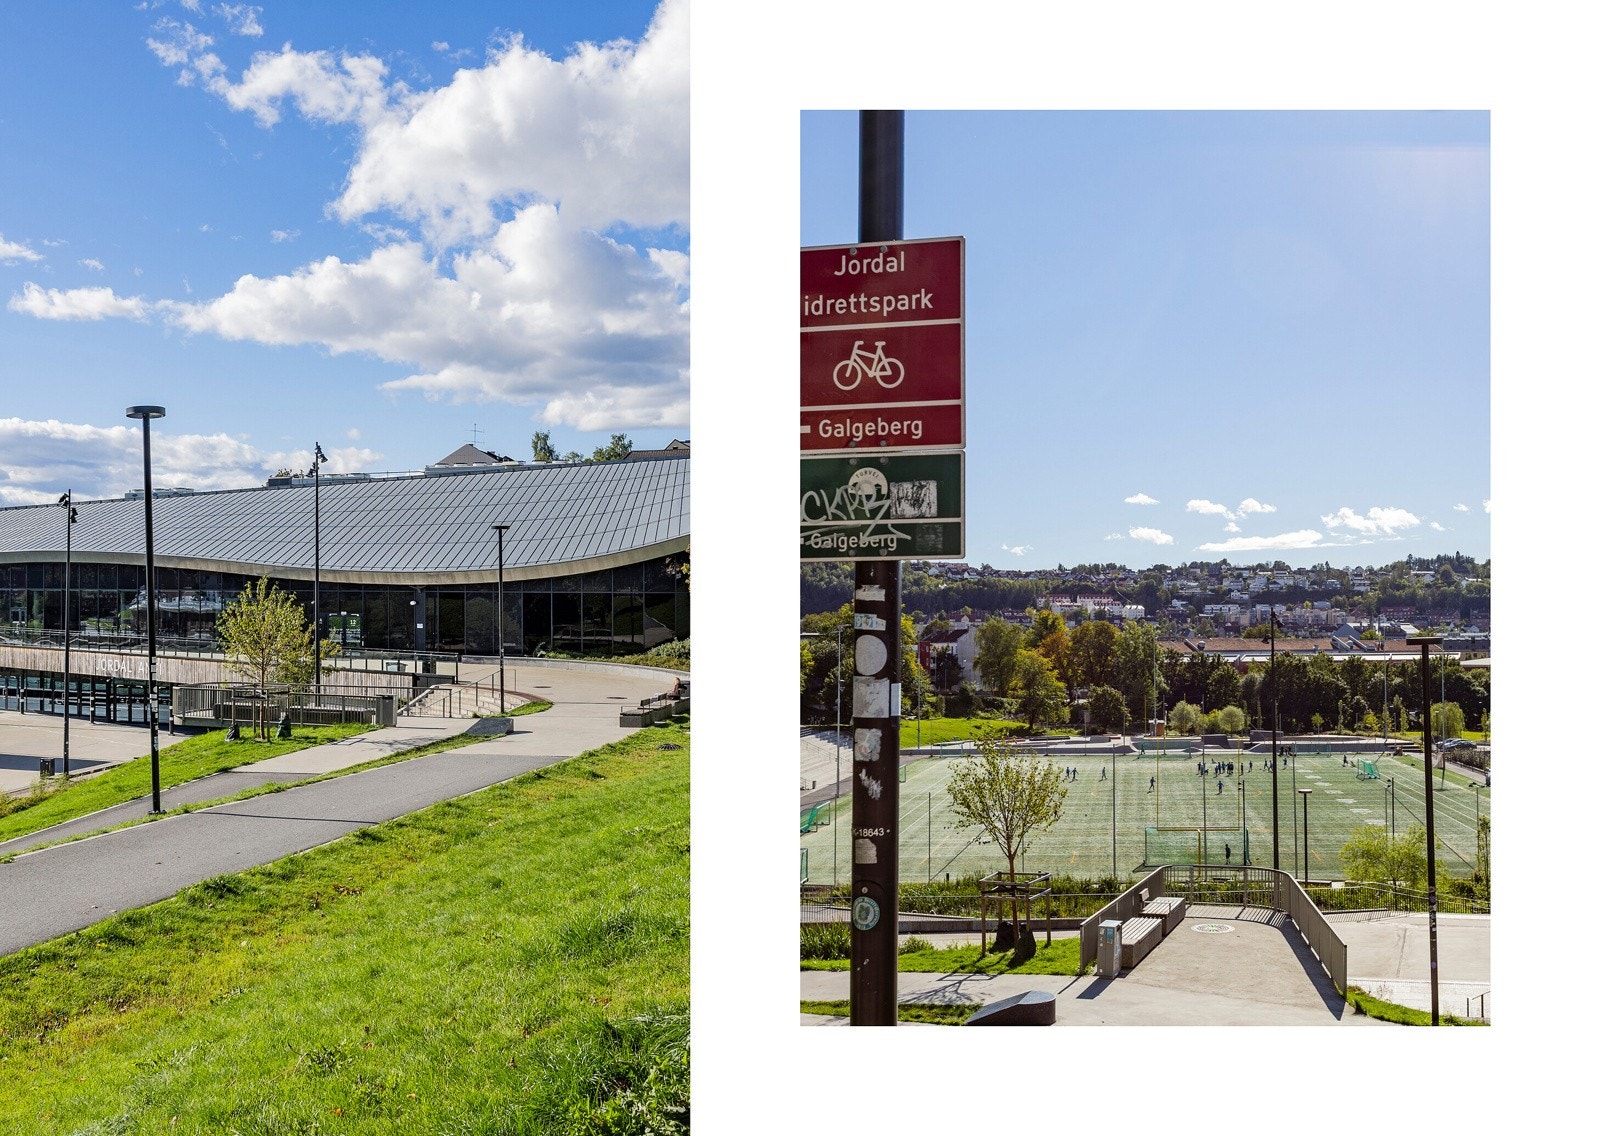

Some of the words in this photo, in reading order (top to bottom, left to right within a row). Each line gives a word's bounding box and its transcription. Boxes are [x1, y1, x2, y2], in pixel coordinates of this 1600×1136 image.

[834, 251, 905, 276] Jordal
[804, 288, 934, 317] idrettspark
[818, 417, 923, 442] Galgeberg
[811, 532, 897, 552] Galgeberg
[95, 659, 132, 673] JORDAL
[138, 662, 162, 676] AI
